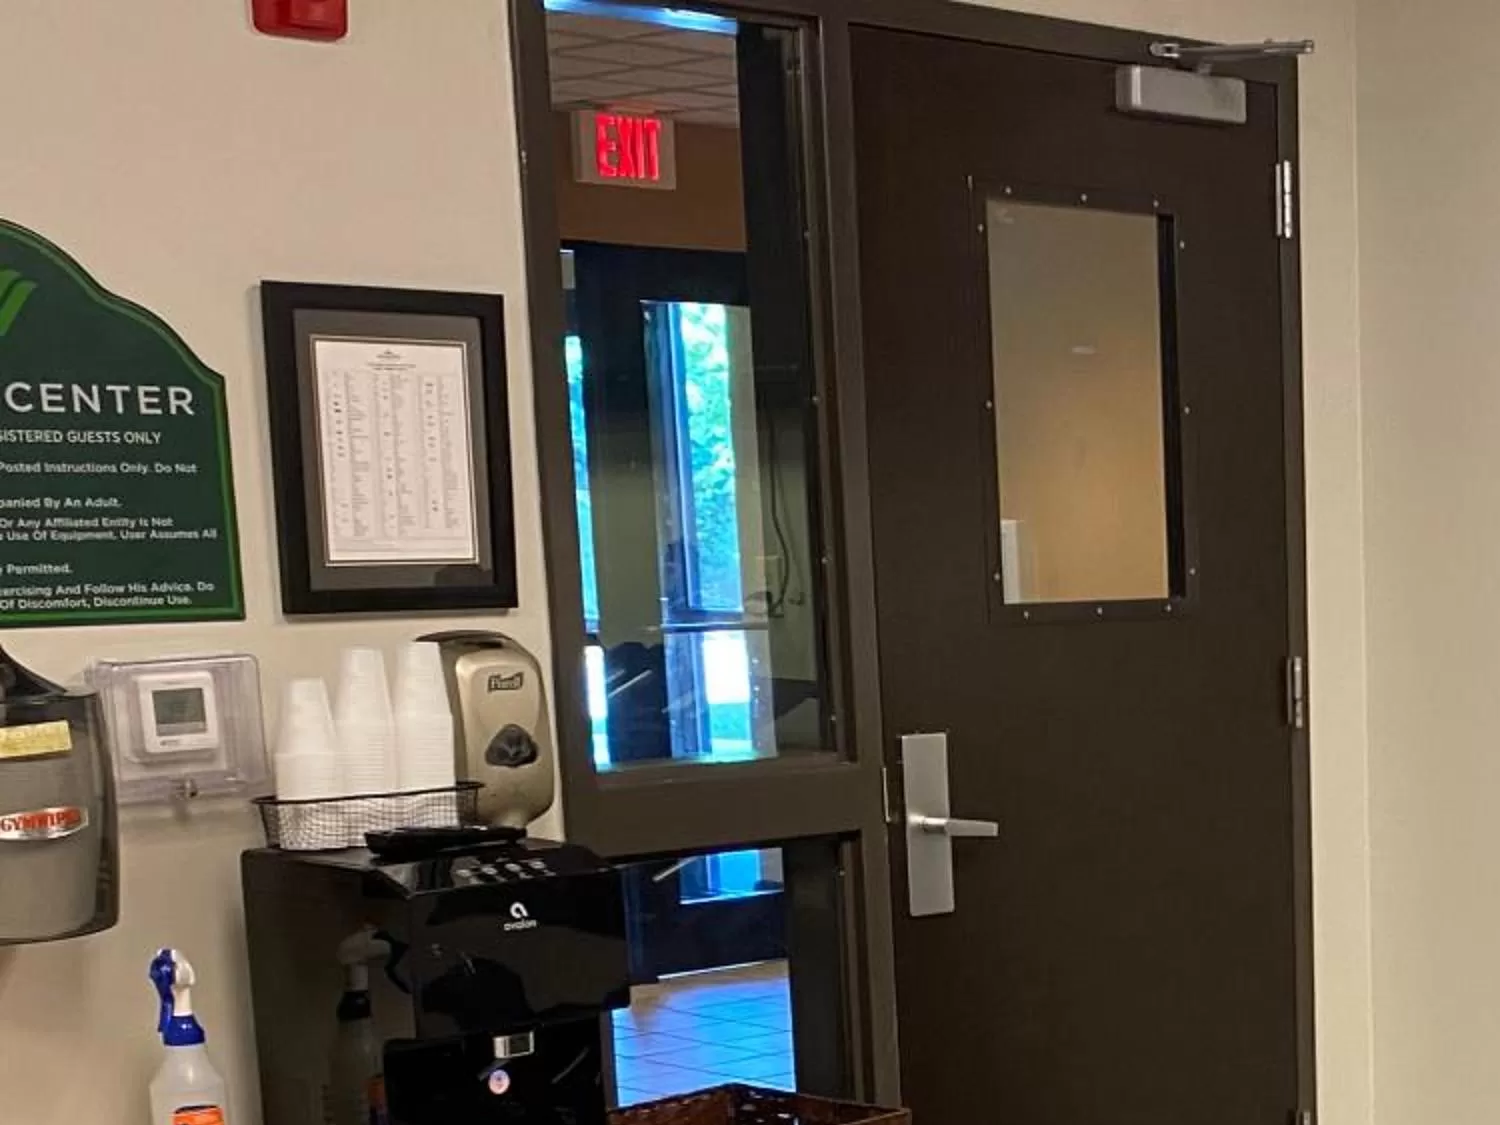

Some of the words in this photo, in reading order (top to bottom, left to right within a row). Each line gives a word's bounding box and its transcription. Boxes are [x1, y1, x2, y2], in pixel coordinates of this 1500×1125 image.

[596, 112, 661, 181] EXIT
[4, 381, 195, 416] CENTER
[66, 430, 120, 443] GUESTS
[123, 431, 161, 444] ONLY
[0, 462, 40, 473] Posted
[44, 462, 117, 473] Instructions
[154, 463, 172, 473] Do
[175, 463, 198, 473] Not
[43, 498, 60, 510] By
[63, 498, 81, 508] An
[85, 498, 122, 508] Adult.
[17, 518, 40, 529] Any
[44, 517, 99, 528] Affiliated
[102, 517, 136, 529] Entity
[139, 518, 149, 527] Is
[152, 517, 174, 527] Not
[7, 530, 29, 541] Use
[32, 530, 47, 540] Of
[120, 529, 146, 539] User
[150, 529, 199, 539] Assumes
[202, 528, 217, 538] All
[7, 563, 73, 575] Permitted.
[56, 584, 81, 595] And
[84, 583, 125, 594] Follow
[128, 583, 147, 593] His
[151, 582, 194, 593] Advice.
[197, 581, 215, 592] Do
[0, 599, 15, 610] Of
[93, 596, 164, 608] Discontinue
